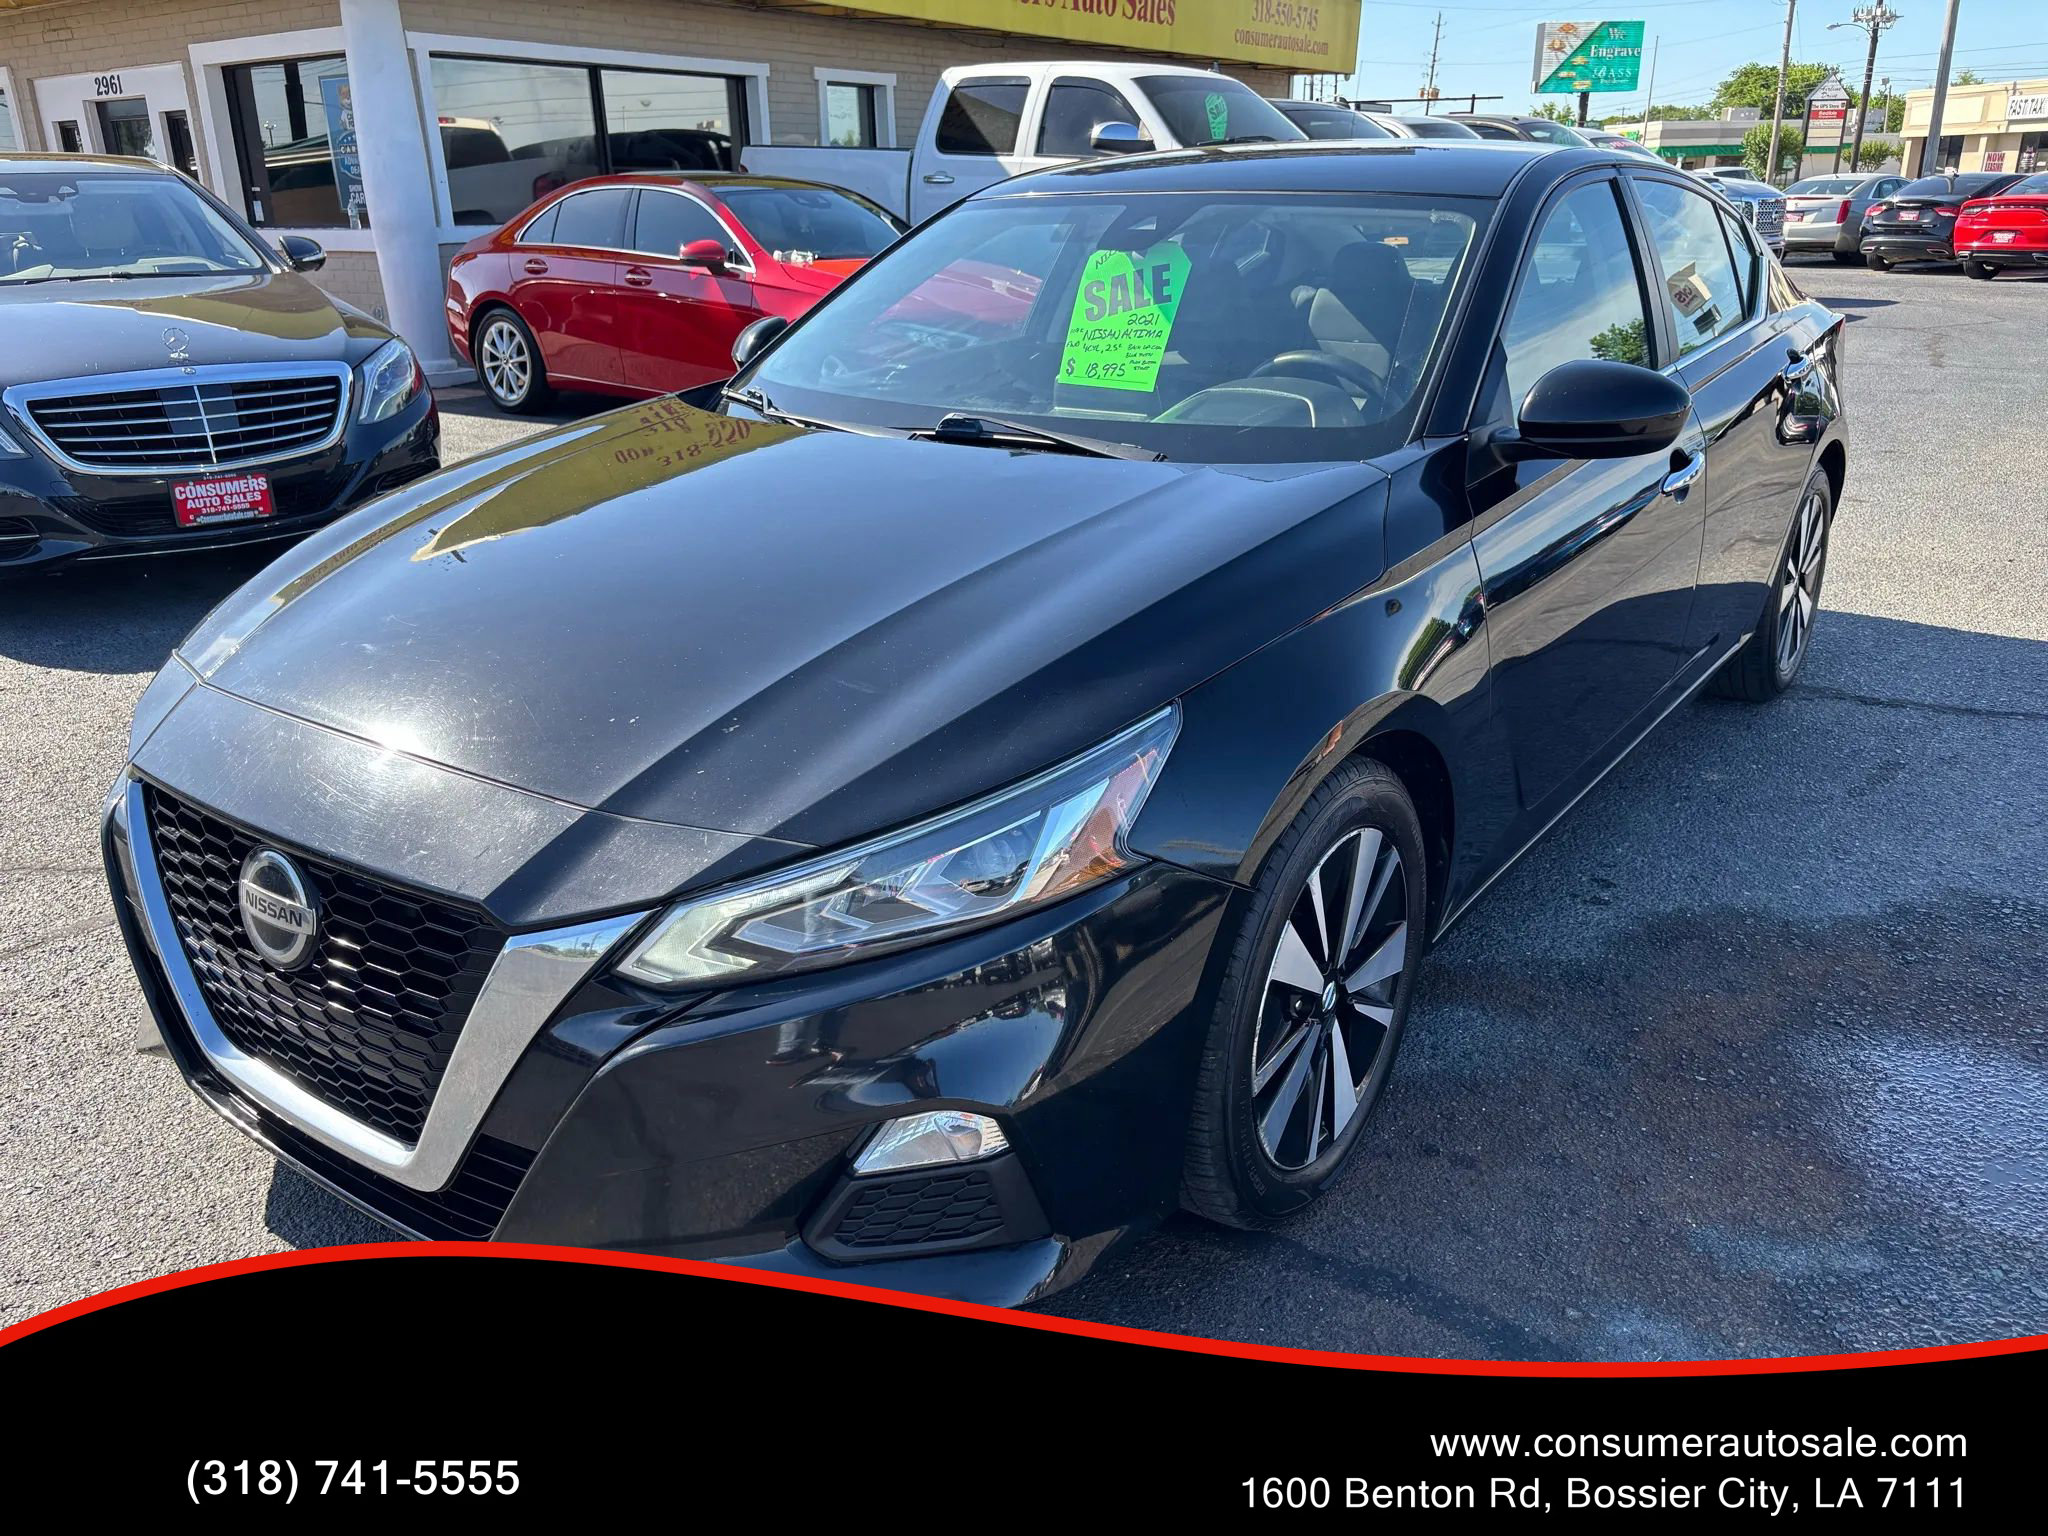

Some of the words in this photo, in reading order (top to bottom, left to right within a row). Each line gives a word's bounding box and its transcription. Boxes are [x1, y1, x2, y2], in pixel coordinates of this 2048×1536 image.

[1122, 0, 1176, 26] Sales
[1251, 0, 1319, 31] 318-550-5745
[1234, 28, 1329, 56] consumerautosale.com
[1590, 44, 1641, 60] Engrave
[94, 74, 123, 96] 2961
[1084, 263, 1172, 322] SALE
[1127, 313, 1160, 326] 2021
[1083, 328, 1121, 341] NISSAN
[1121, 328, 1163, 339] ALTIMA
[1065, 357, 1076, 376] $
[1085, 362, 1126, 379] 18,995
[174, 477, 268, 500] CONSUMERS
[186, 496, 221, 510] AUTO
[223, 491, 262, 505] SALES
[246, 889, 302, 928] NISSAN
